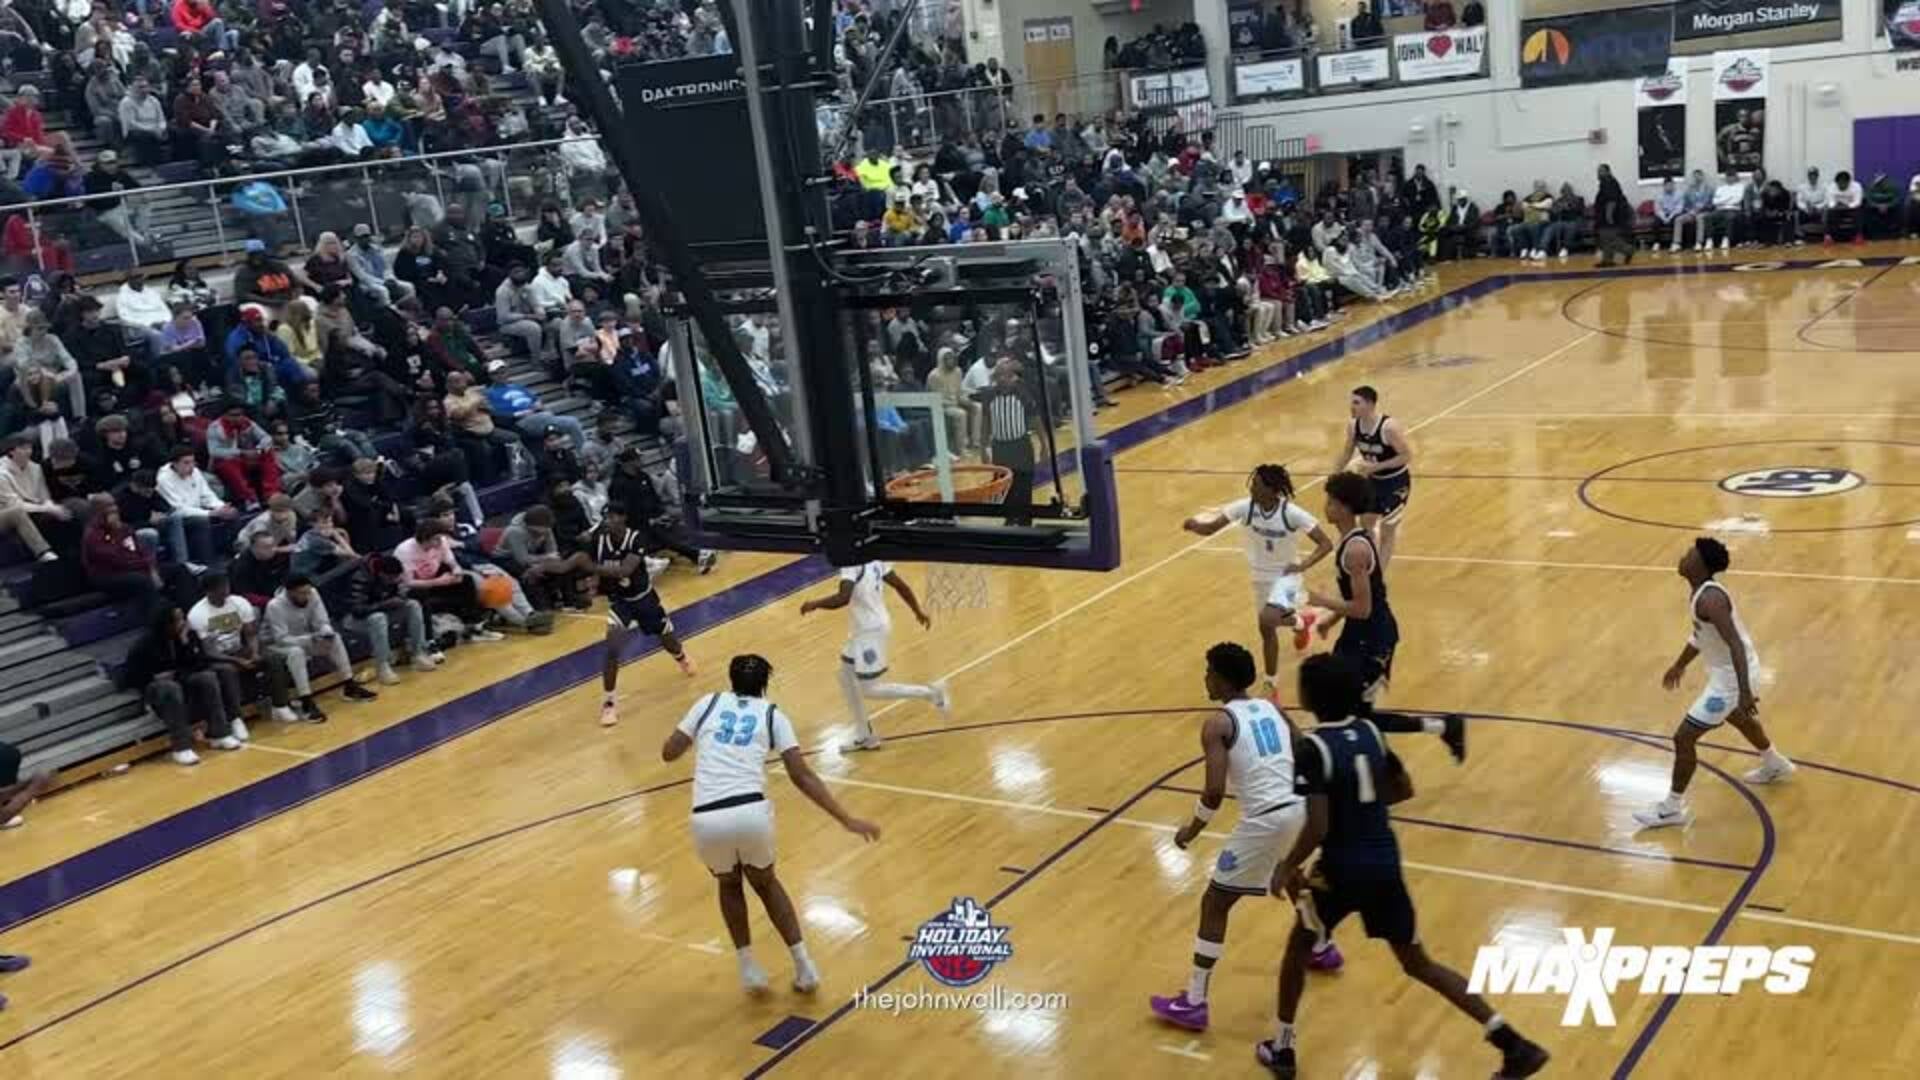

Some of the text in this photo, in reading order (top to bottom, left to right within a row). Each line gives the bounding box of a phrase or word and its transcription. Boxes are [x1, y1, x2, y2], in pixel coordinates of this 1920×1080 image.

[1692, 4, 1820, 31] Morgan Stanley
[1397, 39, 1425, 60] JOHN
[714, 711, 757, 747] 33
[1249, 717, 1282, 757] 10
[1354, 753, 1376, 803] 1
